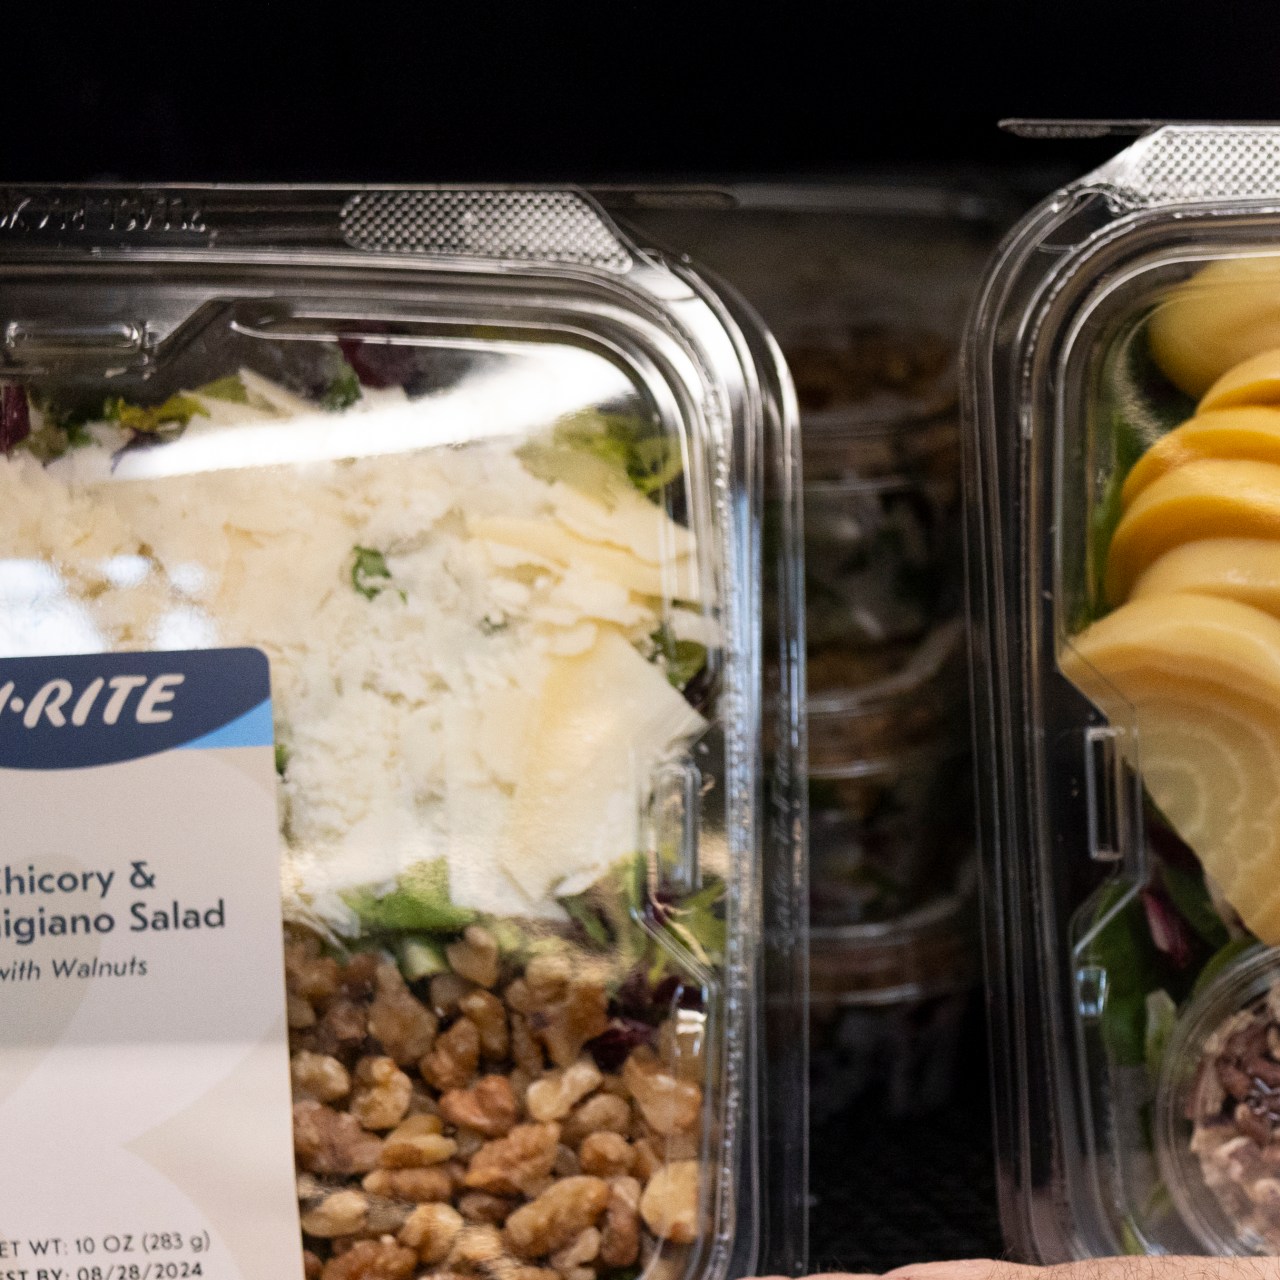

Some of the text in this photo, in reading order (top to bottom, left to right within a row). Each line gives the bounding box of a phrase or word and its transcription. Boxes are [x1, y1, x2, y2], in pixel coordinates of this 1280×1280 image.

[0, 861, 156, 898] hicory &
[0, 898, 226, 946] igiano Salad
[52, 956, 148, 979] Walnuts
[28, 1237, 68, 1256] WT:
[76, 1235, 96, 1254] 10
[103, 1234, 134, 1253] OZ
[142, 1232, 183, 1255] (283
[190, 1229, 211, 1253] g)
